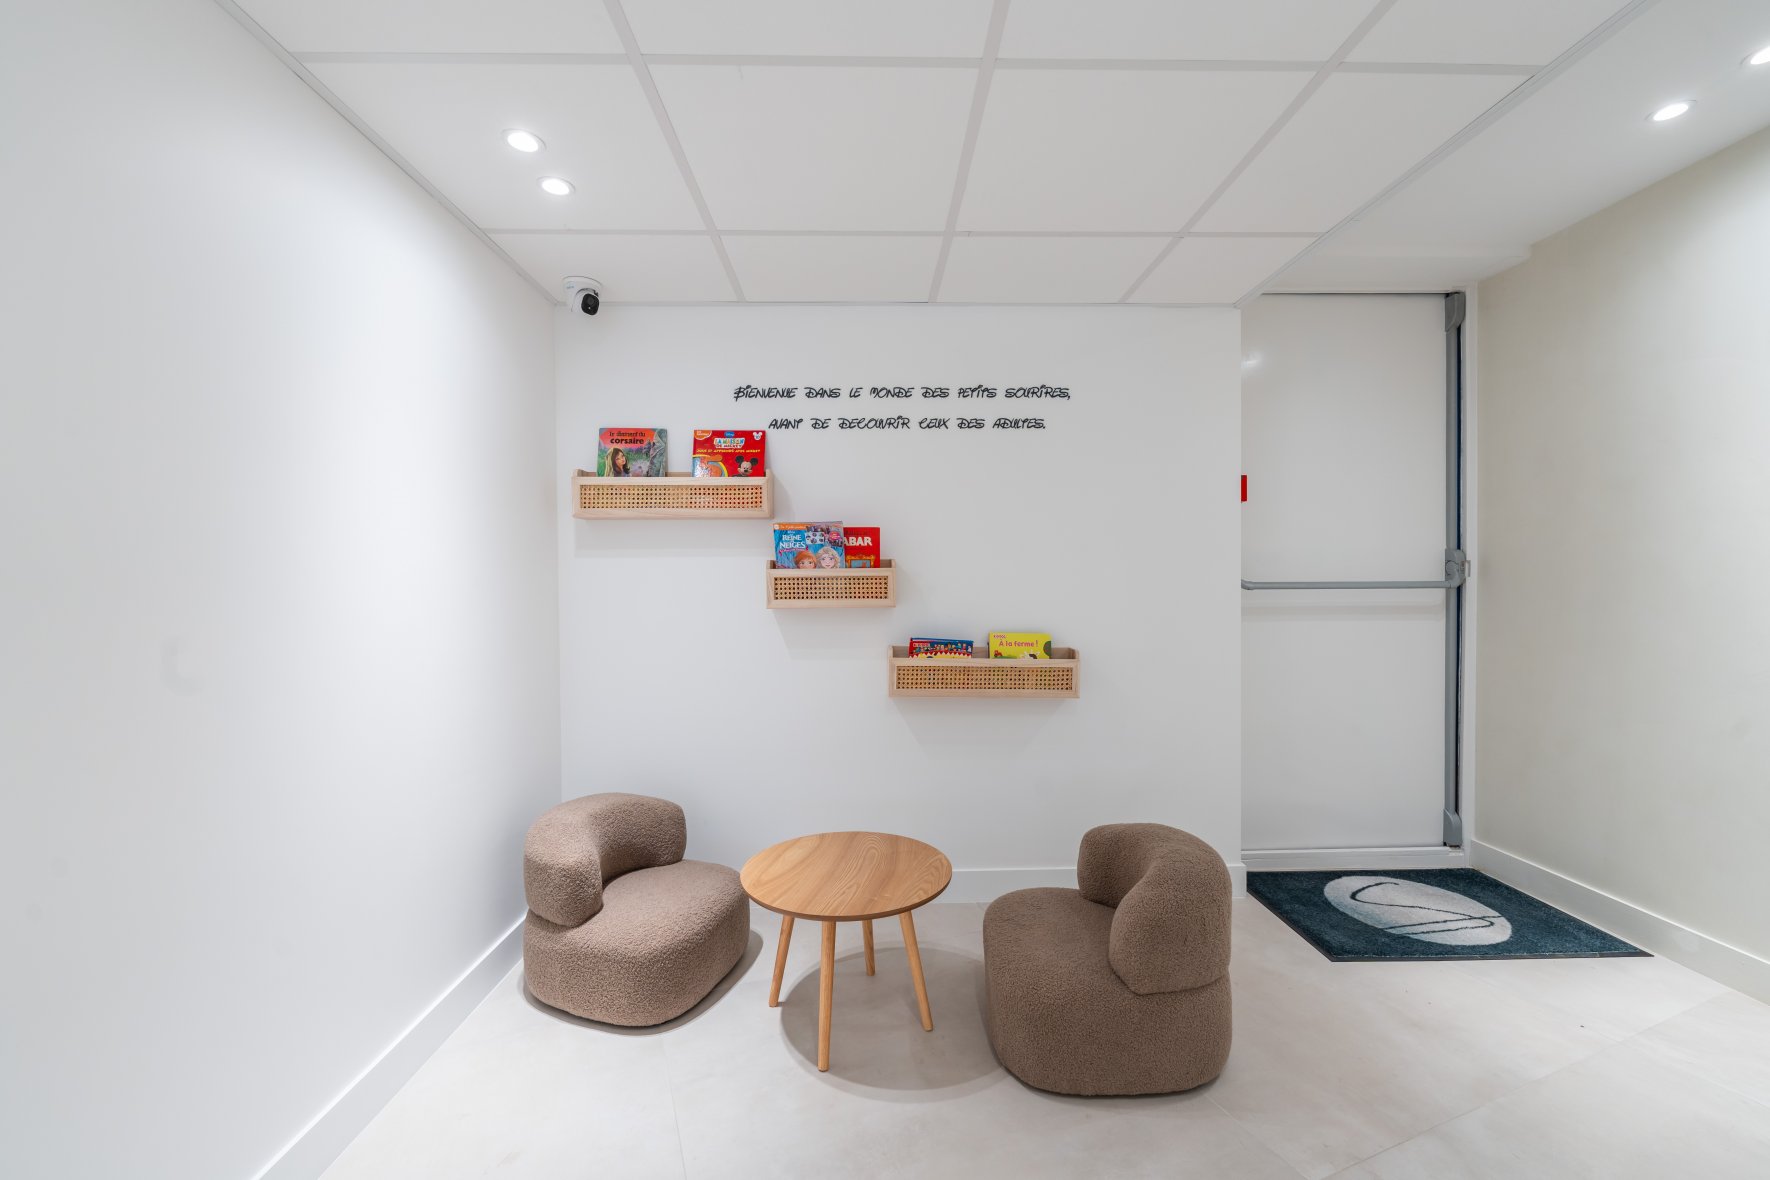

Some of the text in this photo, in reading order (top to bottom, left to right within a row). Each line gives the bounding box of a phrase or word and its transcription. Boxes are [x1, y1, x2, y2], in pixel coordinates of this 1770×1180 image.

[733, 384, 1071, 401] BIENVENUE DANS LE MONDE DES PETITS SOURIRES,
[768, 415, 1045, 429] AVANT DE DECOUVRIR CEUX DES ADULTES.
[779, 541, 806, 549] NEIGES
[843, 536, 872, 546] ABAR
